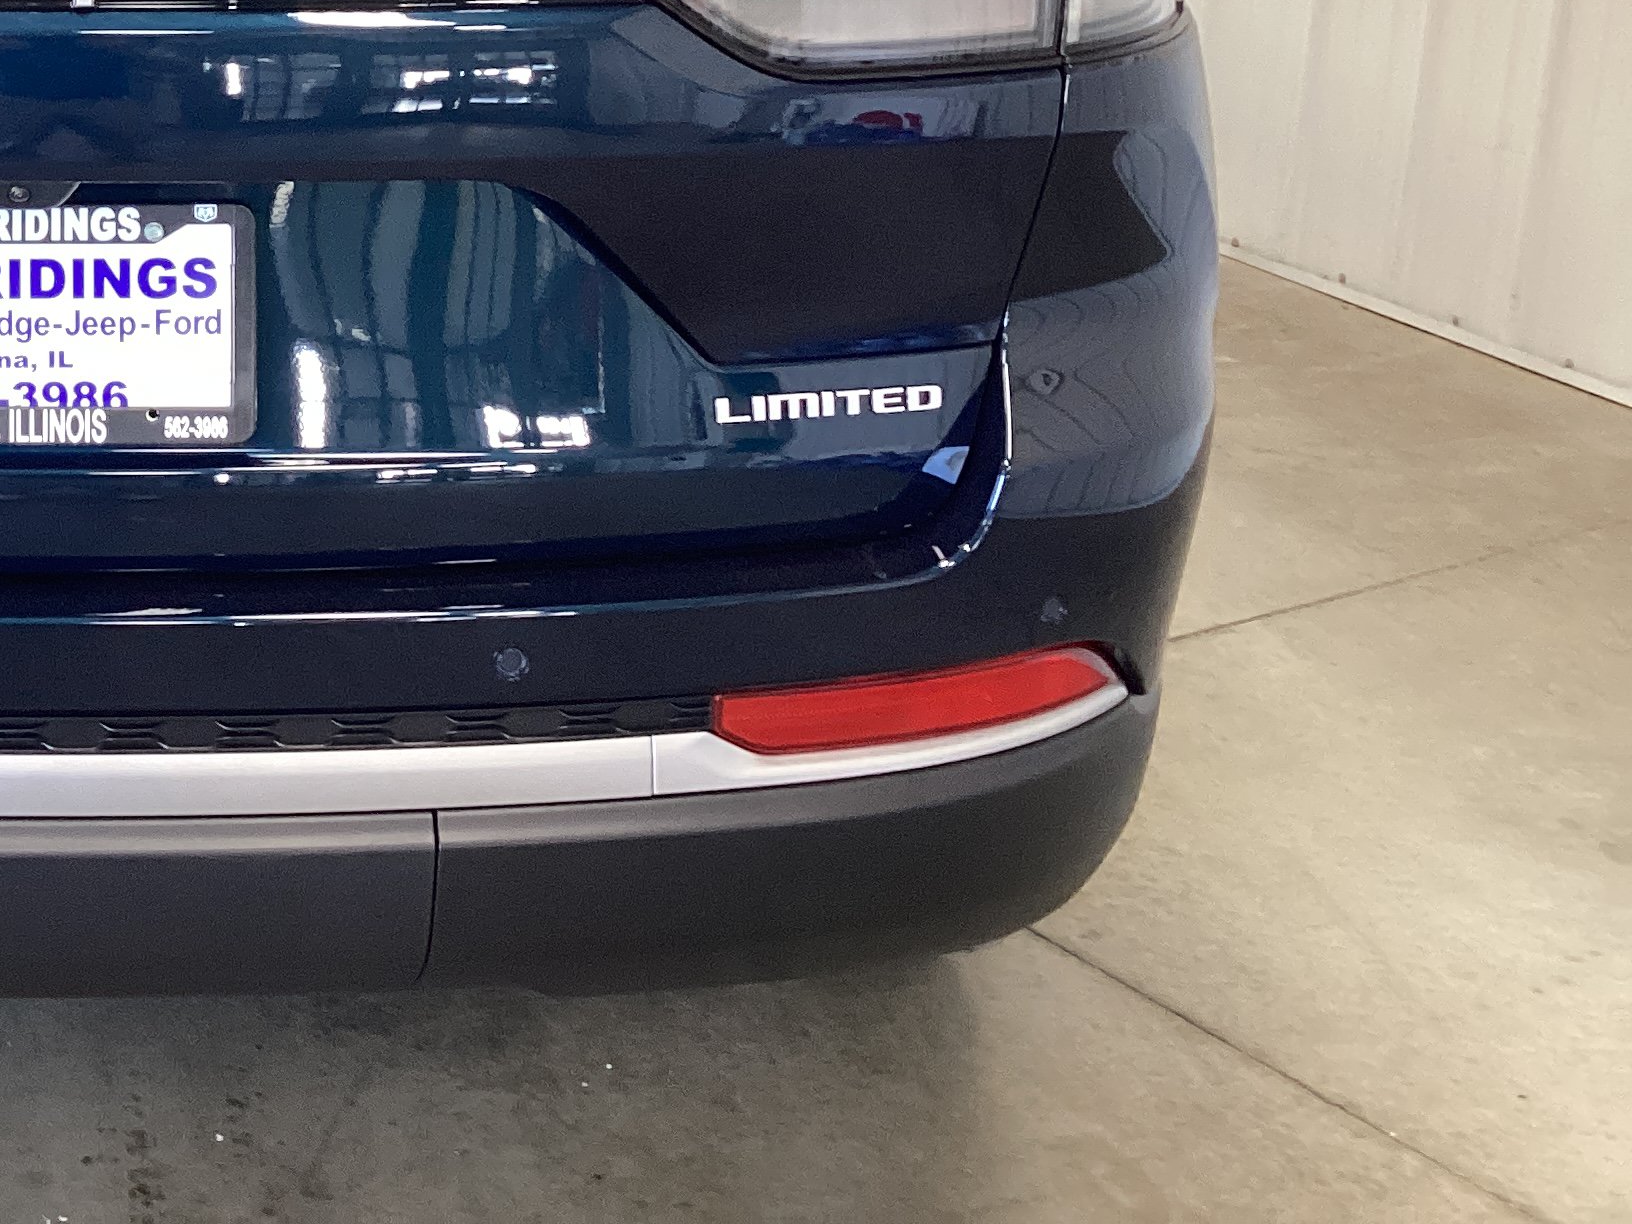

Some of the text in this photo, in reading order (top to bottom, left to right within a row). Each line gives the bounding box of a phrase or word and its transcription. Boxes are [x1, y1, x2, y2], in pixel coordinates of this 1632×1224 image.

[48, 350, 74, 369] IL
[714, 384, 943, 424] LIMITED
[8, 408, 108, 444] ILLINOIS
